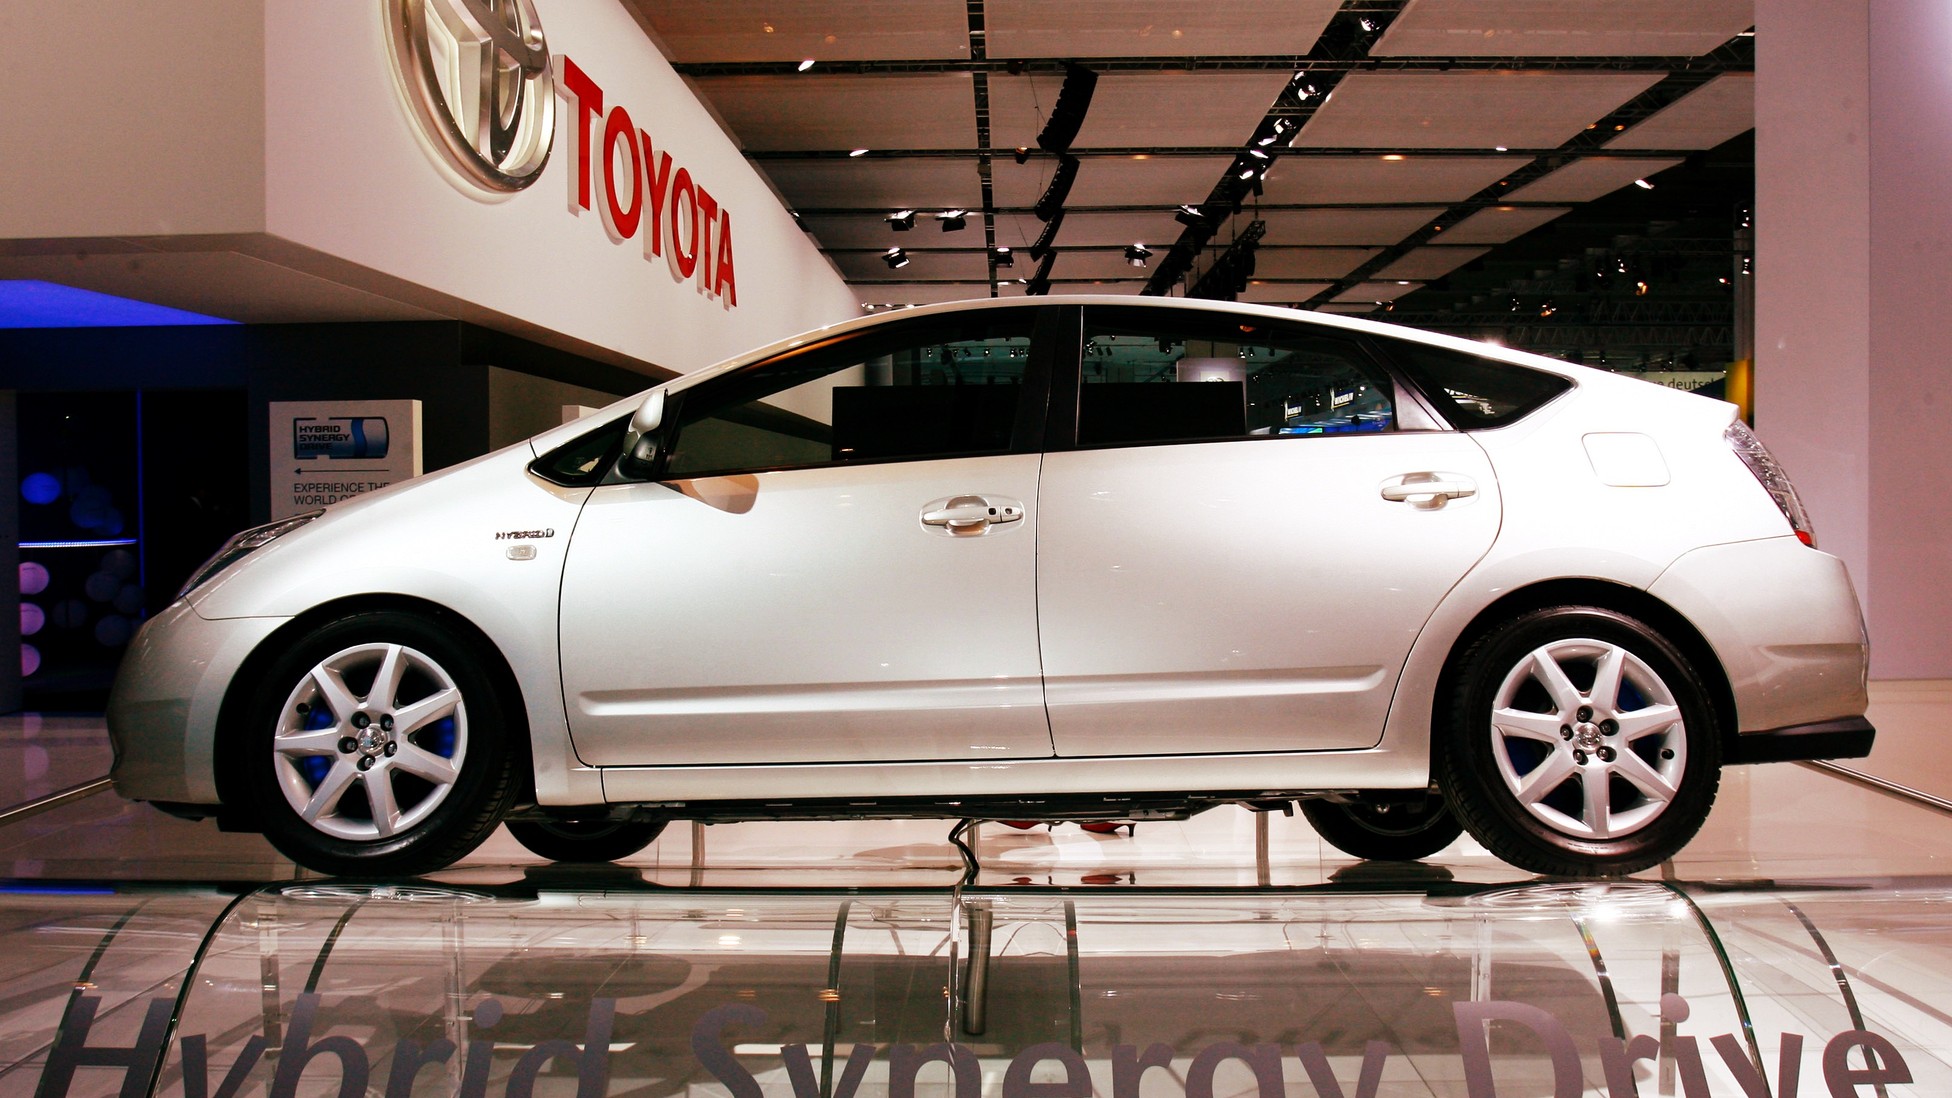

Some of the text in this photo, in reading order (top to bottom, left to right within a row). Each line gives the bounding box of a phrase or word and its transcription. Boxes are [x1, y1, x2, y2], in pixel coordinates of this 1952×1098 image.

[553, 54, 737, 308] TOYOTA
[1668, 378, 1714, 389] deuts
[299, 425, 341, 433] HYBRID
[299, 433, 350, 441] SYNERGY
[299, 442, 333, 450] DRIVE
[294, 482, 364, 493] EXPERIENCE
[294, 494, 337, 505] WORLD
[1452, 993, 1914, 1098] Drive
